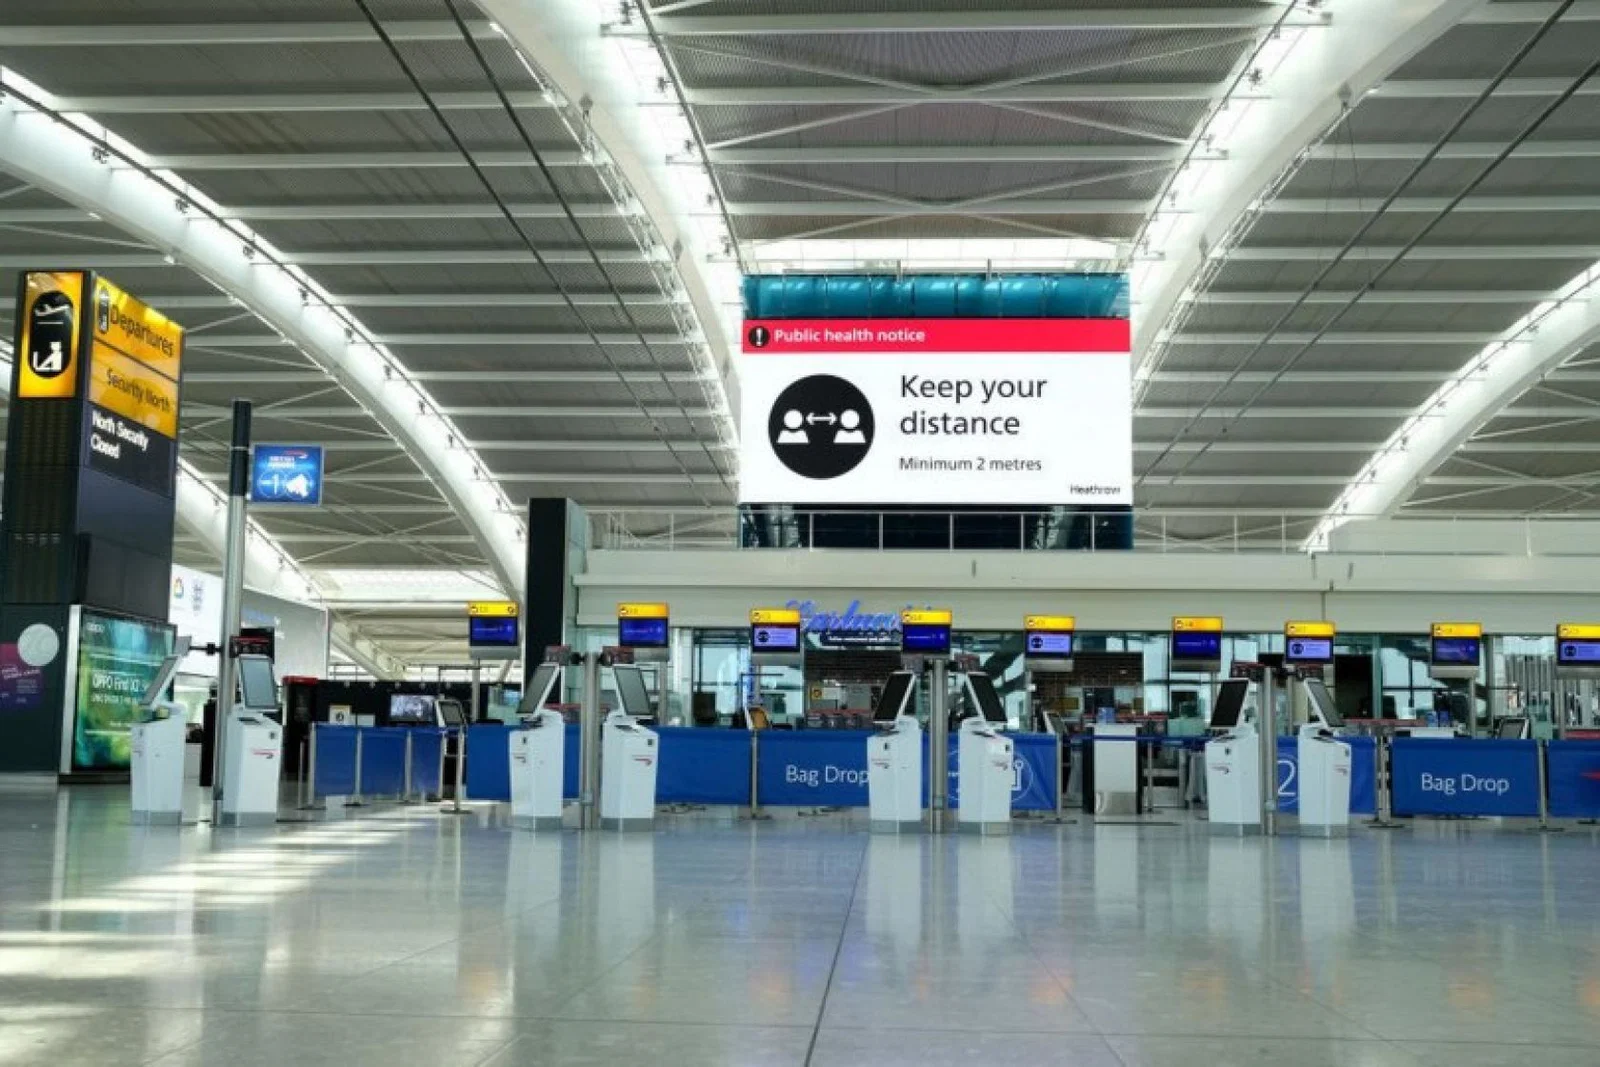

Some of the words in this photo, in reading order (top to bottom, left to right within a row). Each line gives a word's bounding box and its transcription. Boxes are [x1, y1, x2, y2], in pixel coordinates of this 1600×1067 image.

[110, 304, 175, 358] Departures
[774, 328, 821, 342] Public
[824, 328, 874, 342] health
[877, 328, 926, 342] notice
[106, 367, 144, 404] Security
[145, 389, 171, 413] North
[901, 375, 973, 404] Keep
[981, 379, 1048, 404] your
[92, 410, 116, 434] North
[116, 420, 149, 451] Security
[900, 410, 1020, 435] distance
[90, 433, 121, 459] Closed
[900, 457, 973, 471] Minimum
[976, 457, 986, 471] 2
[989, 458, 1042, 471] metres
[1069, 484, 1121, 496] Heathrow
[785, 764, 819, 787] Bag
[825, 765, 869, 787] Drop
[1421, 772, 1456, 795] Bag
[1461, 773, 1510, 796] Drop
